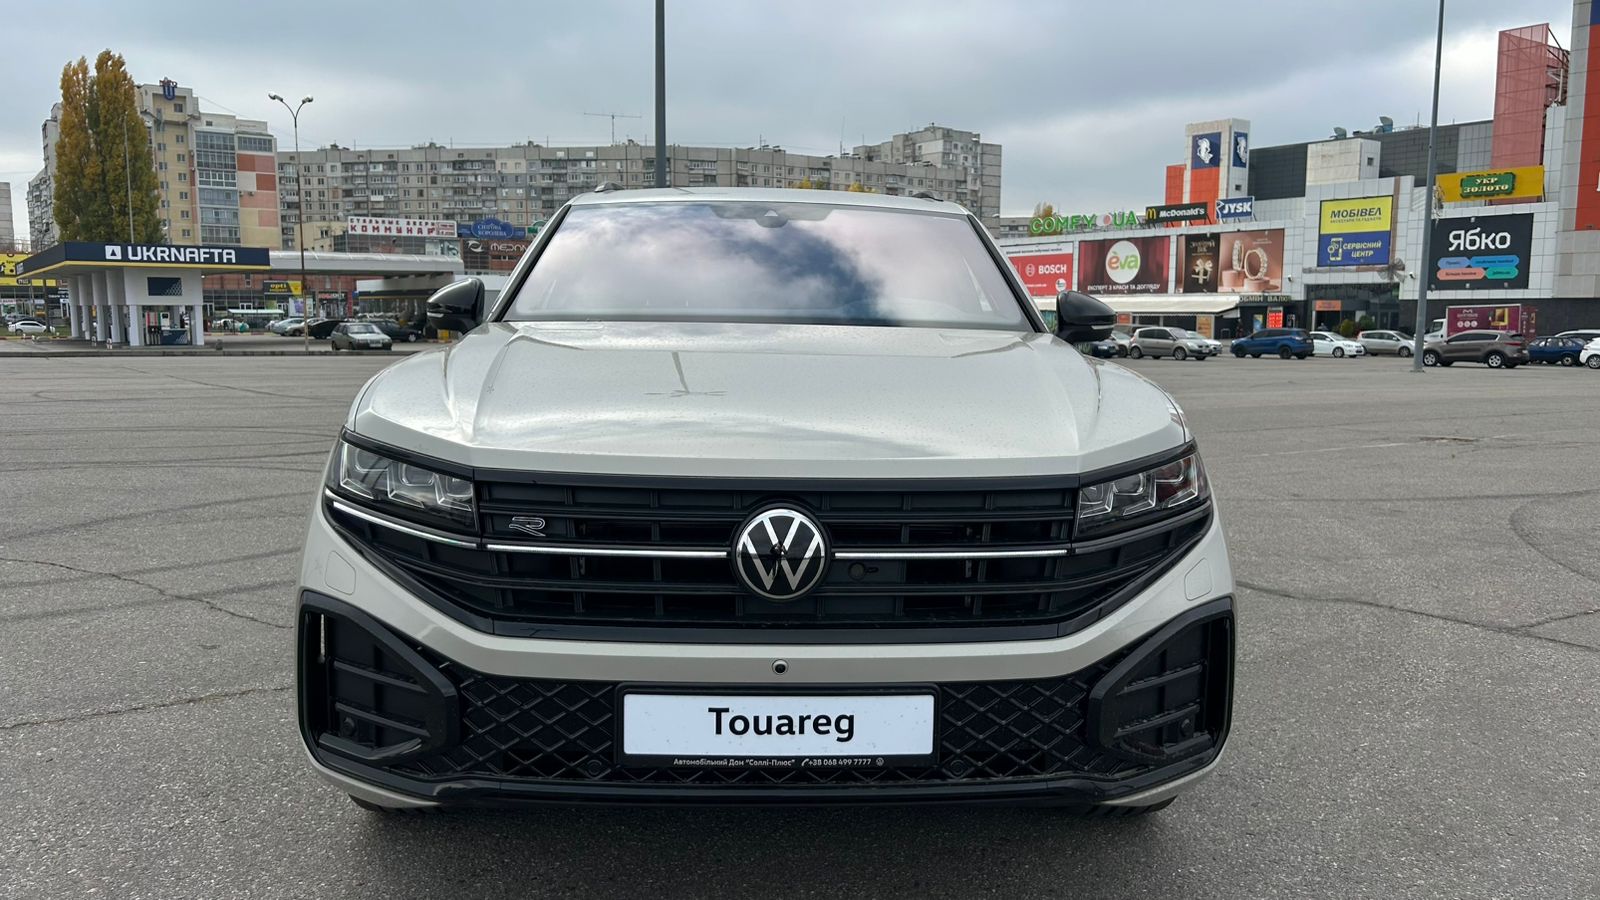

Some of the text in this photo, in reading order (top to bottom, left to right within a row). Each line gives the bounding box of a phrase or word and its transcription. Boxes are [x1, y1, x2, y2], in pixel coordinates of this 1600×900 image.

[1475, 177, 1499, 185] УКР
[1463, 184, 1509, 193] ЗОЛОТО
[1159, 207, 1205, 218] McDonald's
[1222, 201, 1252, 214] JYSK
[1330, 207, 1382, 219] МОБІВЕЛ
[1030, 213, 1098, 234] COMFY
[1343, 239, 1383, 250] СЕРВІСНИЙ
[1448, 227, 1512, 252] Ябко
[127, 244, 236, 264] UKRNAFTA
[1351, 250, 1374, 259] ЦЕНТР
[1038, 264, 1067, 275] BOSCH
[707, 707, 855, 742] Touareg
[673, 757, 728, 766] Автомобільний
[808, 758, 822, 766] +38
[823, 758, 838, 766] 068
[838, 758, 853, 766] 499
[853, 758, 872, 766] 7777
